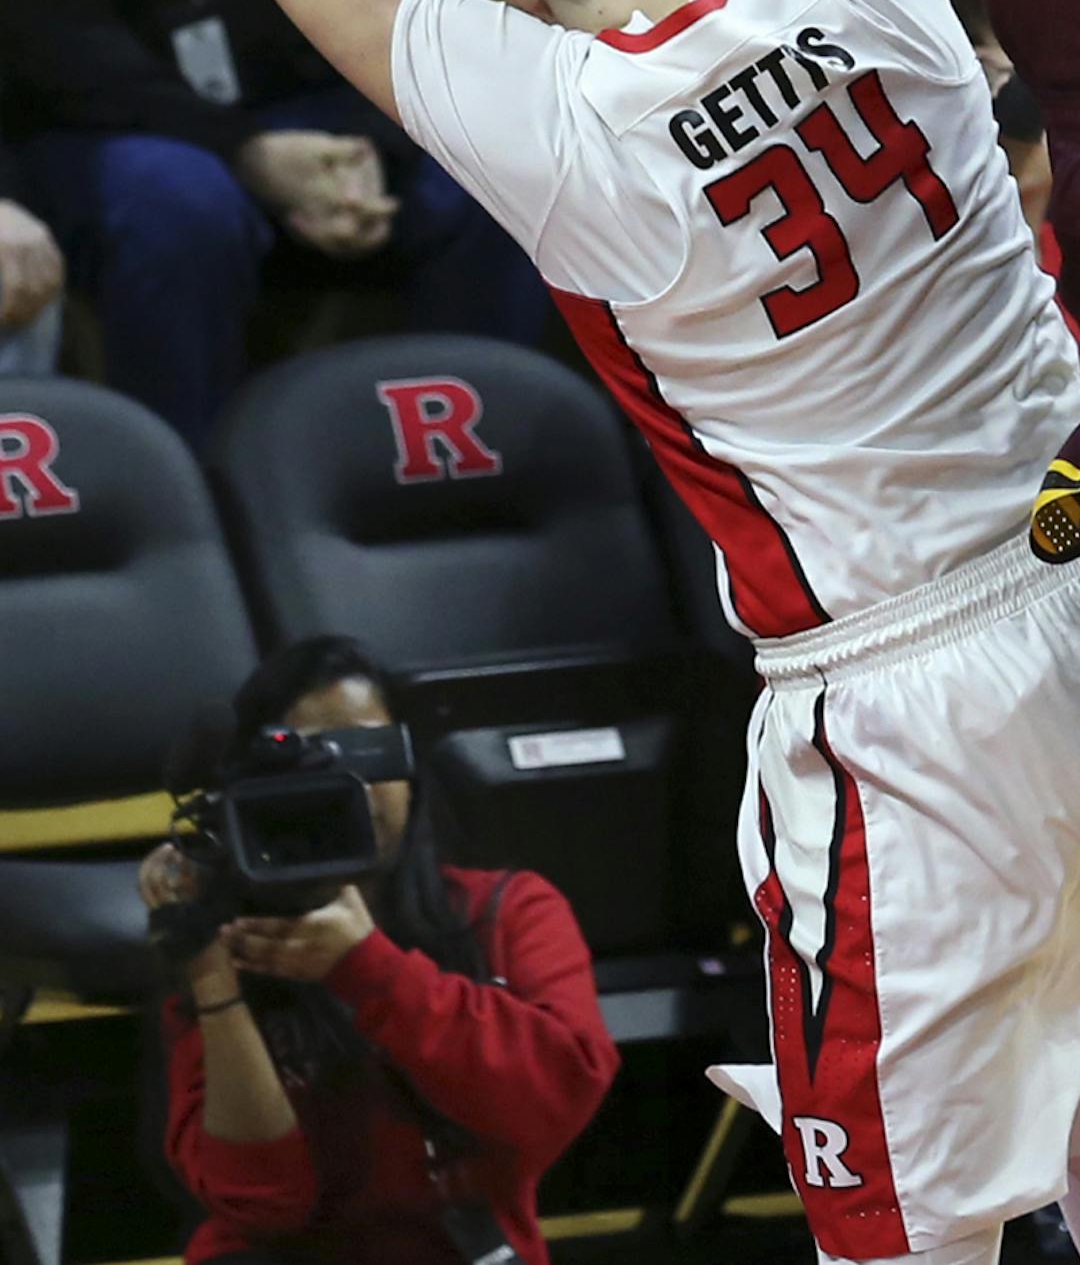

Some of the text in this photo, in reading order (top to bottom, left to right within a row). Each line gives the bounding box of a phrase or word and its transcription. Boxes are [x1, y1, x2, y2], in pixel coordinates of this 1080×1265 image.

[701, 68, 961, 341] 34
[376, 374, 503, 485] R
[792, 1116, 864, 1189] R
